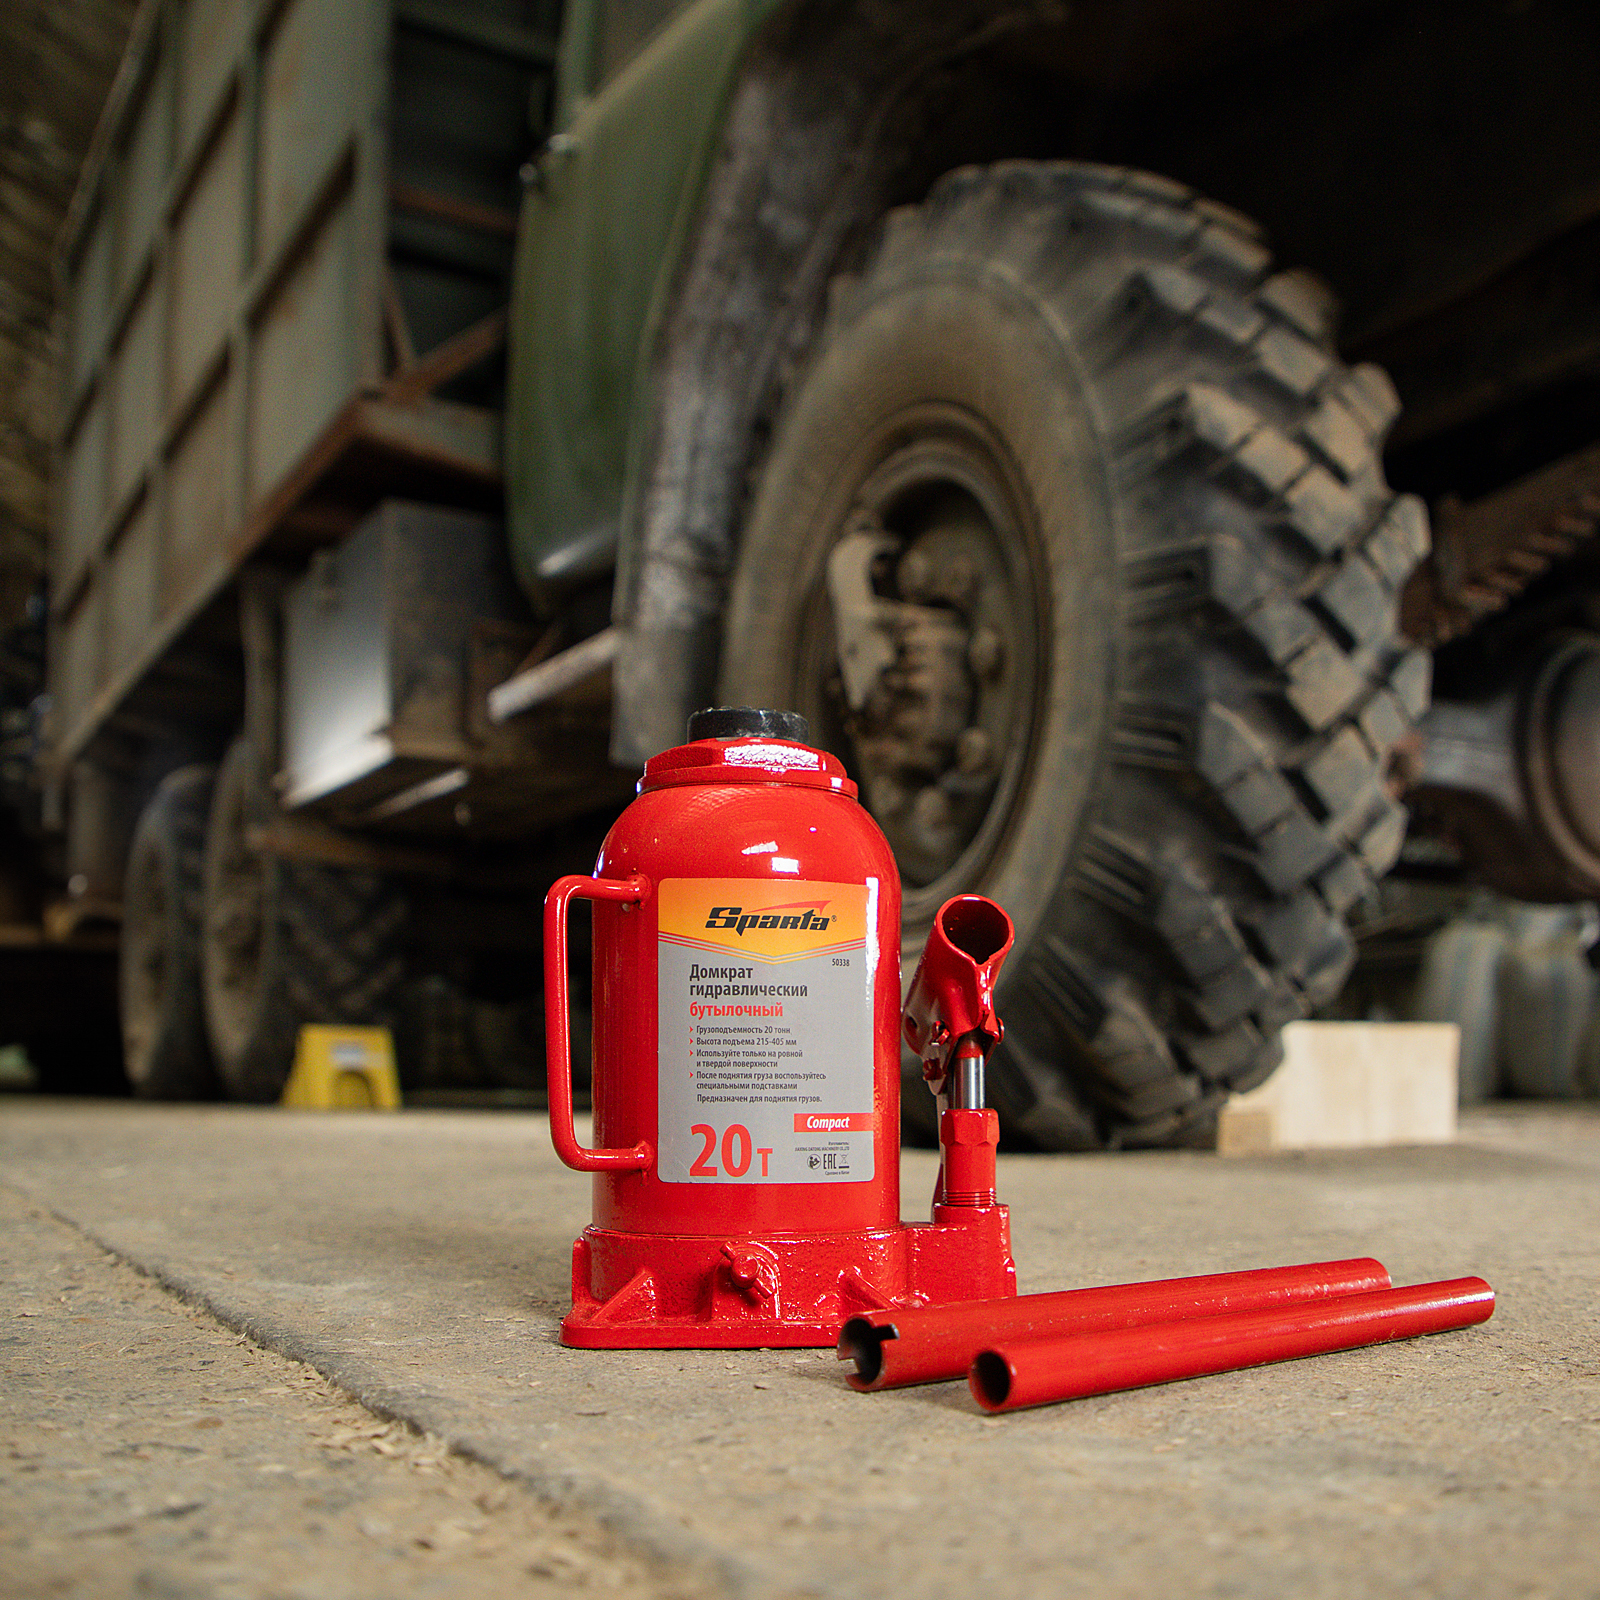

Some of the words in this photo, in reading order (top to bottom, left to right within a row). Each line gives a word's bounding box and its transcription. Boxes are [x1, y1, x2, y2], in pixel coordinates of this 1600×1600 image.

[832, 958, 850, 967] 50338
[689, 964, 753, 982] Домкрат
[689, 985, 808, 999] гидравлический
[689, 1002, 783, 1020] бутылочный
[696, 1025, 763, 1035] Грузоподъемность
[764, 1025, 773, 1034] 20
[696, 1037, 721, 1045] Высота
[756, 1037, 784, 1046] 215-405
[696, 1049, 741, 1059] Используйте
[777, 1050, 803, 1059] ровной
[702, 1060, 732, 1069] твердой
[732, 1061, 778, 1069] поверхности
[696, 1071, 718, 1079] После
[753, 1073, 773, 1081] груза
[774, 1072, 827, 1081] воспользуйтесь
[697, 1094, 748, 1103] Предназначен
[798, 1096, 823, 1104] грузов.
[806, 1115, 850, 1131] Compact
